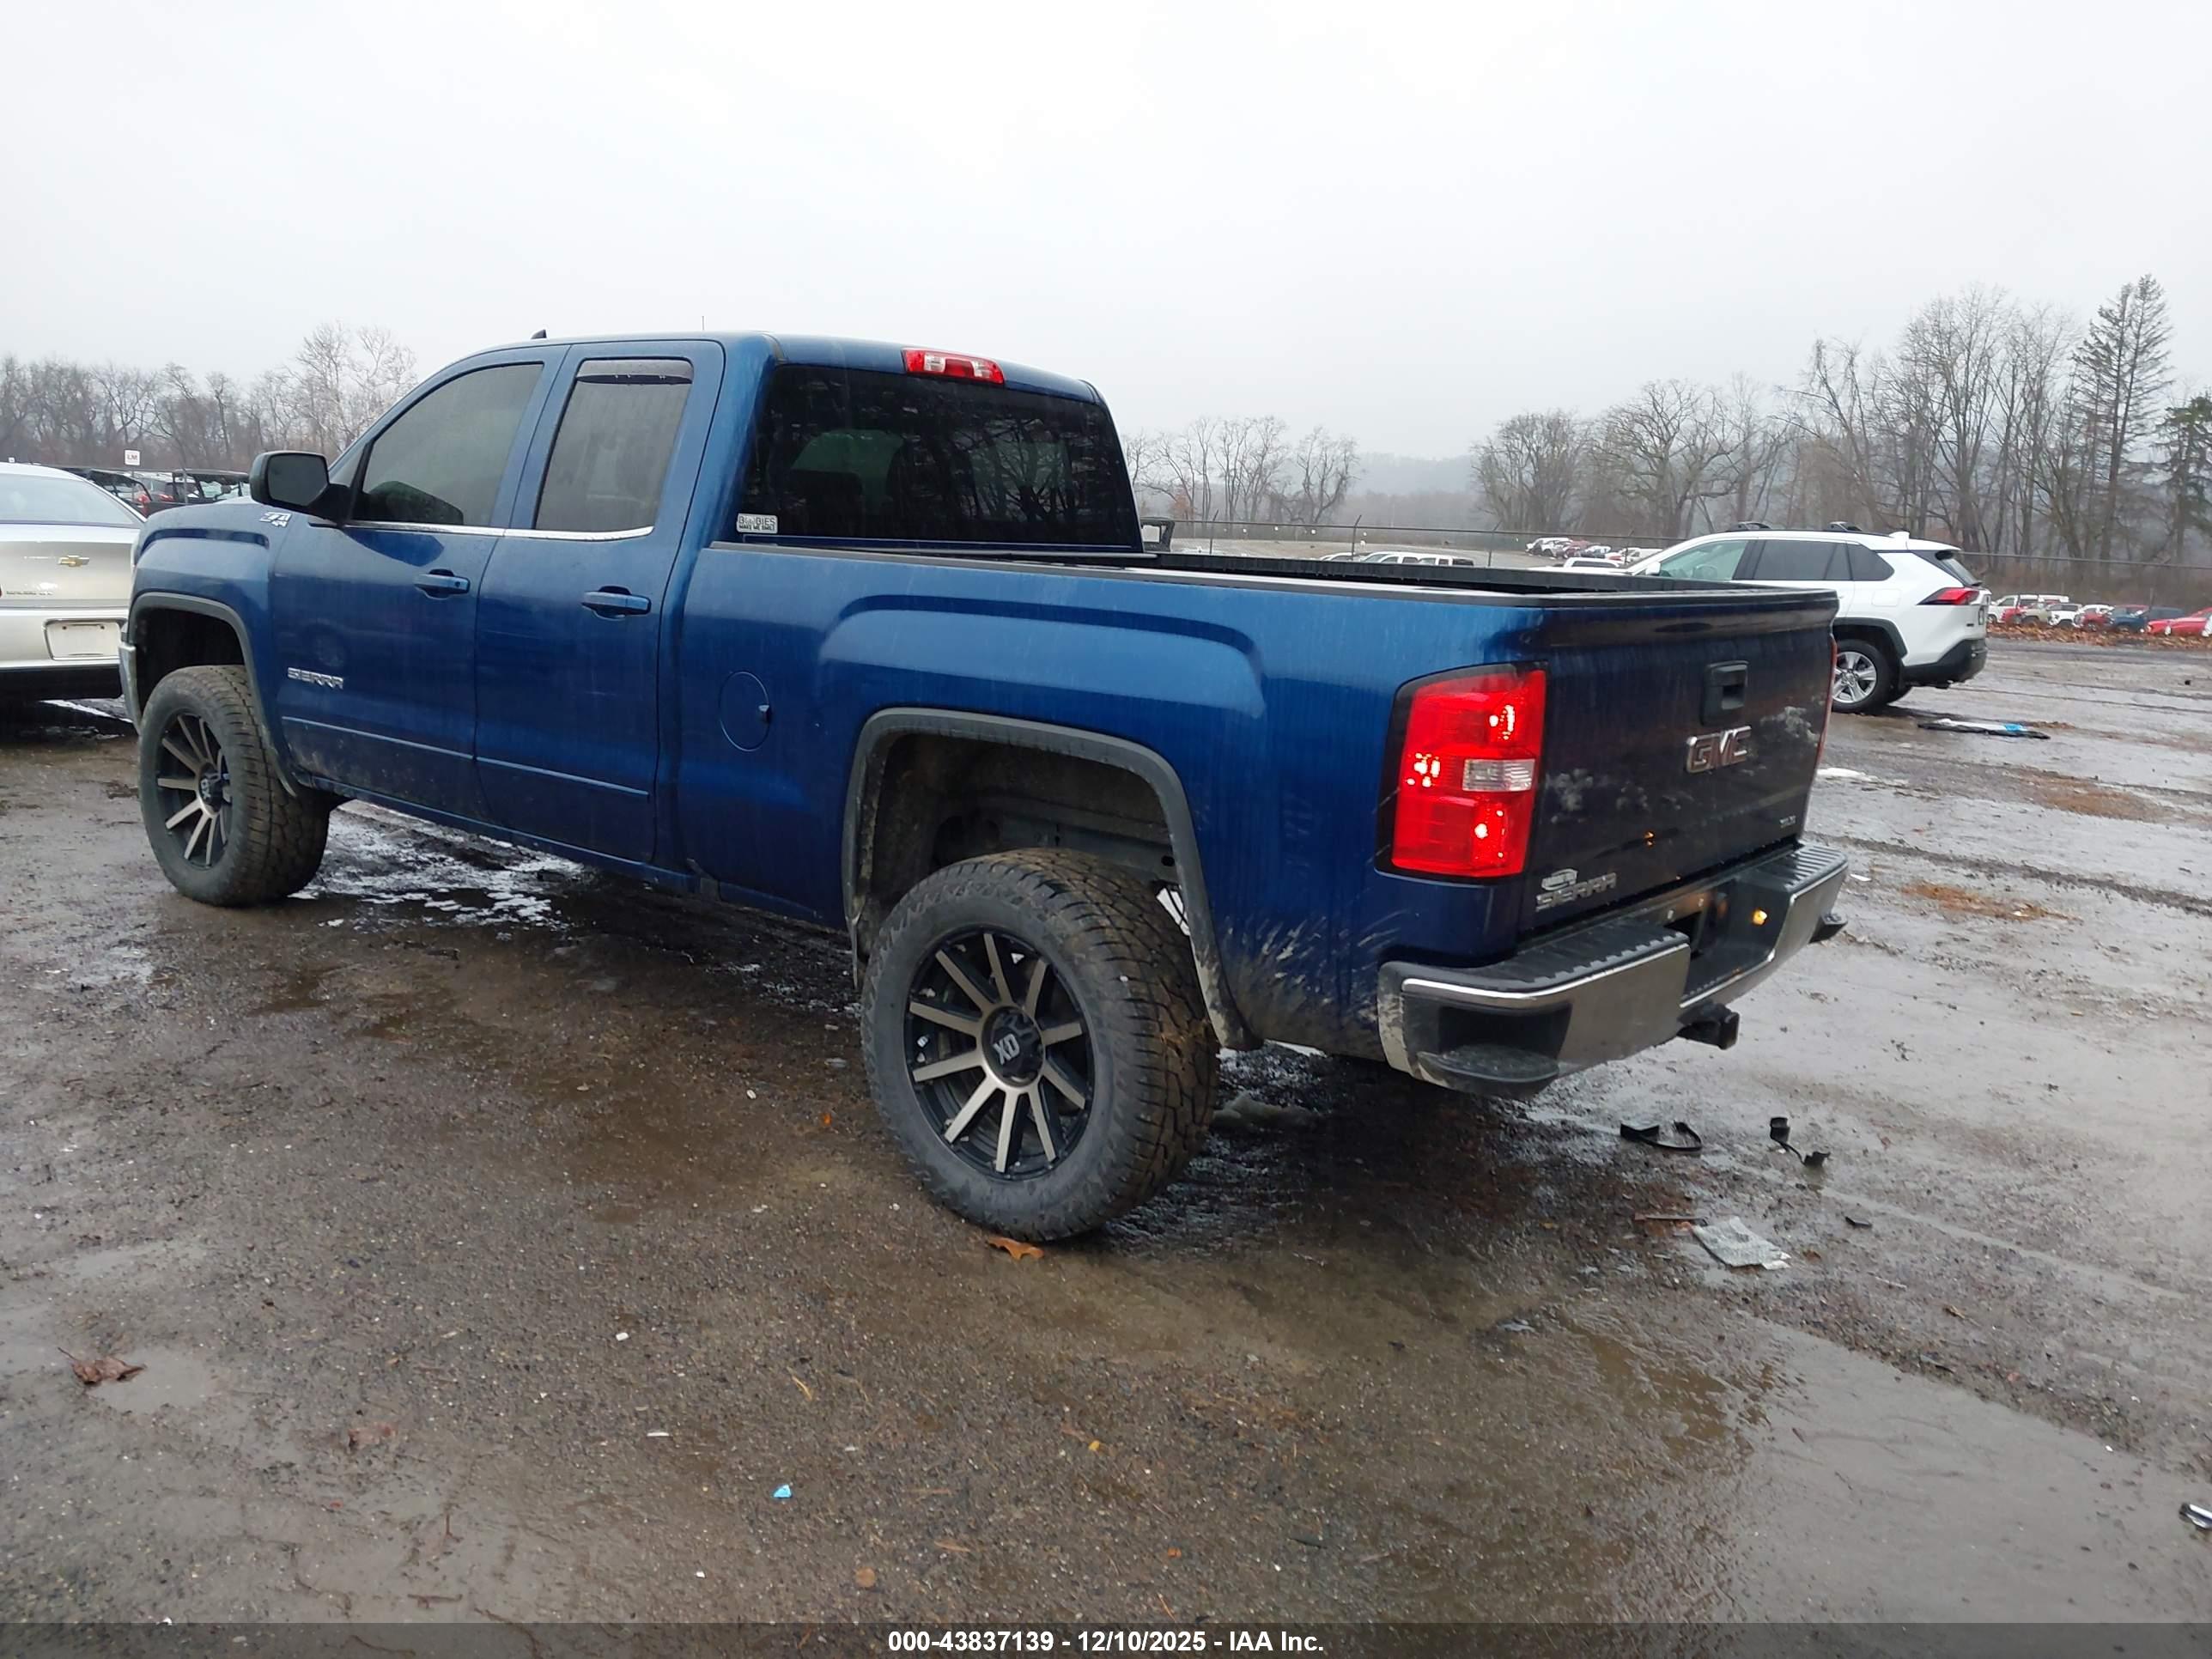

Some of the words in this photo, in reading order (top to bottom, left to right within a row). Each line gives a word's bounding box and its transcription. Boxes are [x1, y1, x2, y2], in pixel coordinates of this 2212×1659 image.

[288, 666, 343, 689] SIERRA
[1686, 725, 1752, 774] GMC
[1534, 872, 1617, 912] SIERRA
[993, 1033, 1020, 1065] XD
